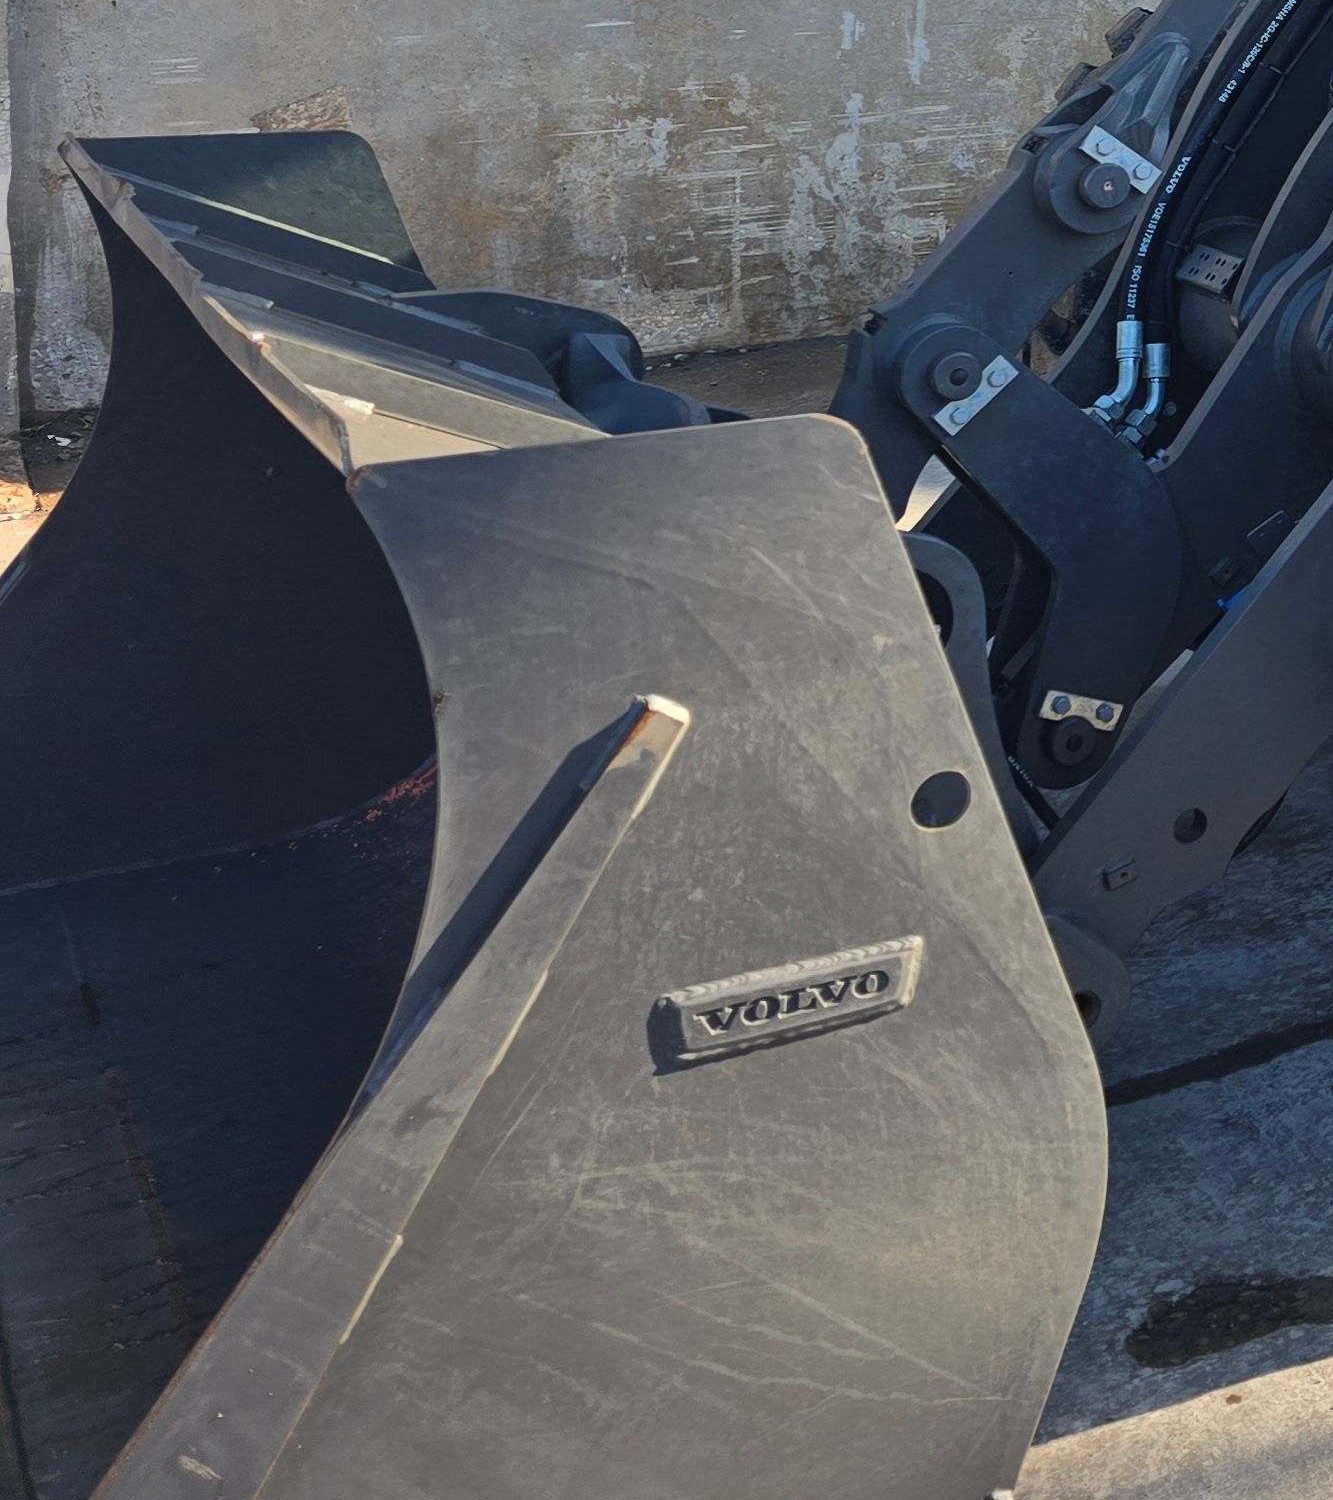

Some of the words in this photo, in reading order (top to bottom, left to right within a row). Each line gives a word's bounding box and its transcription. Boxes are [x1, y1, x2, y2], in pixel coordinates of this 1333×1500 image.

[1165, 155, 1192, 194] VOLVO
[1130, 264, 1144, 283] ISO
[692, 969, 890, 1036] VOLVO
